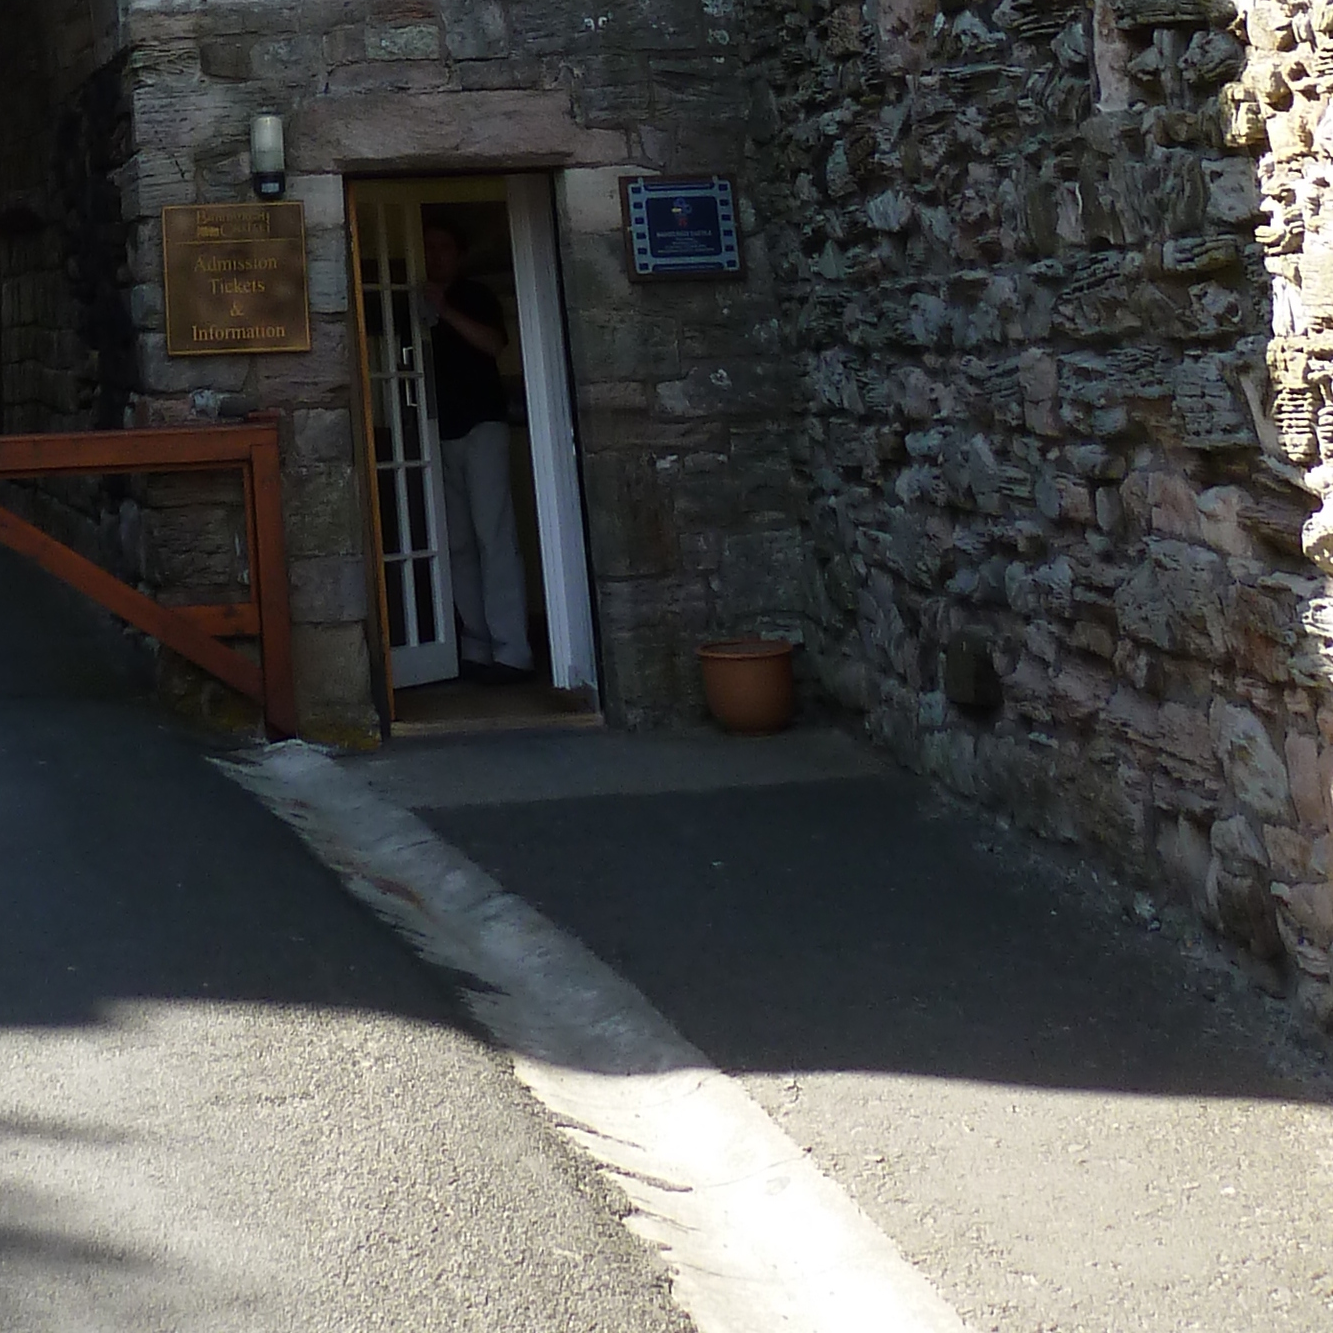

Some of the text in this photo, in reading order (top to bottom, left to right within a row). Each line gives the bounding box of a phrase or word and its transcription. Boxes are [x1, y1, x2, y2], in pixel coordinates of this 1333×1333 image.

[193, 256, 277, 272] Admission
[208, 276, 266, 295] Tickets
[229, 300, 245, 317] &
[191, 324, 286, 341] Information
